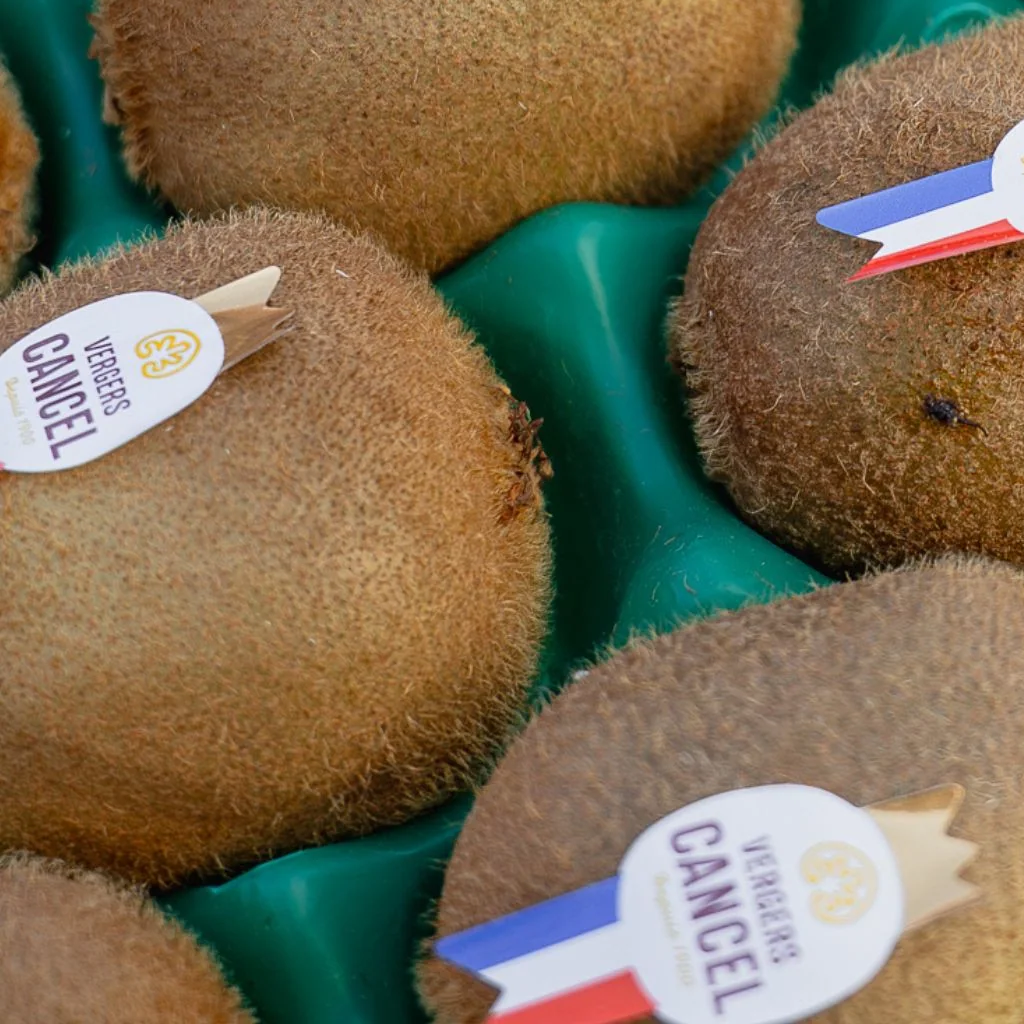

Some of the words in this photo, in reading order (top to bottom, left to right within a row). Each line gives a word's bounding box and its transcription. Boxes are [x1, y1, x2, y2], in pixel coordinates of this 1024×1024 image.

[22, 332, 98, 460] CANCEL
[83, 335, 132, 417] VERGERS
[670, 820, 763, 1016] CANCEL
[742, 834, 803, 965] VERGERS
